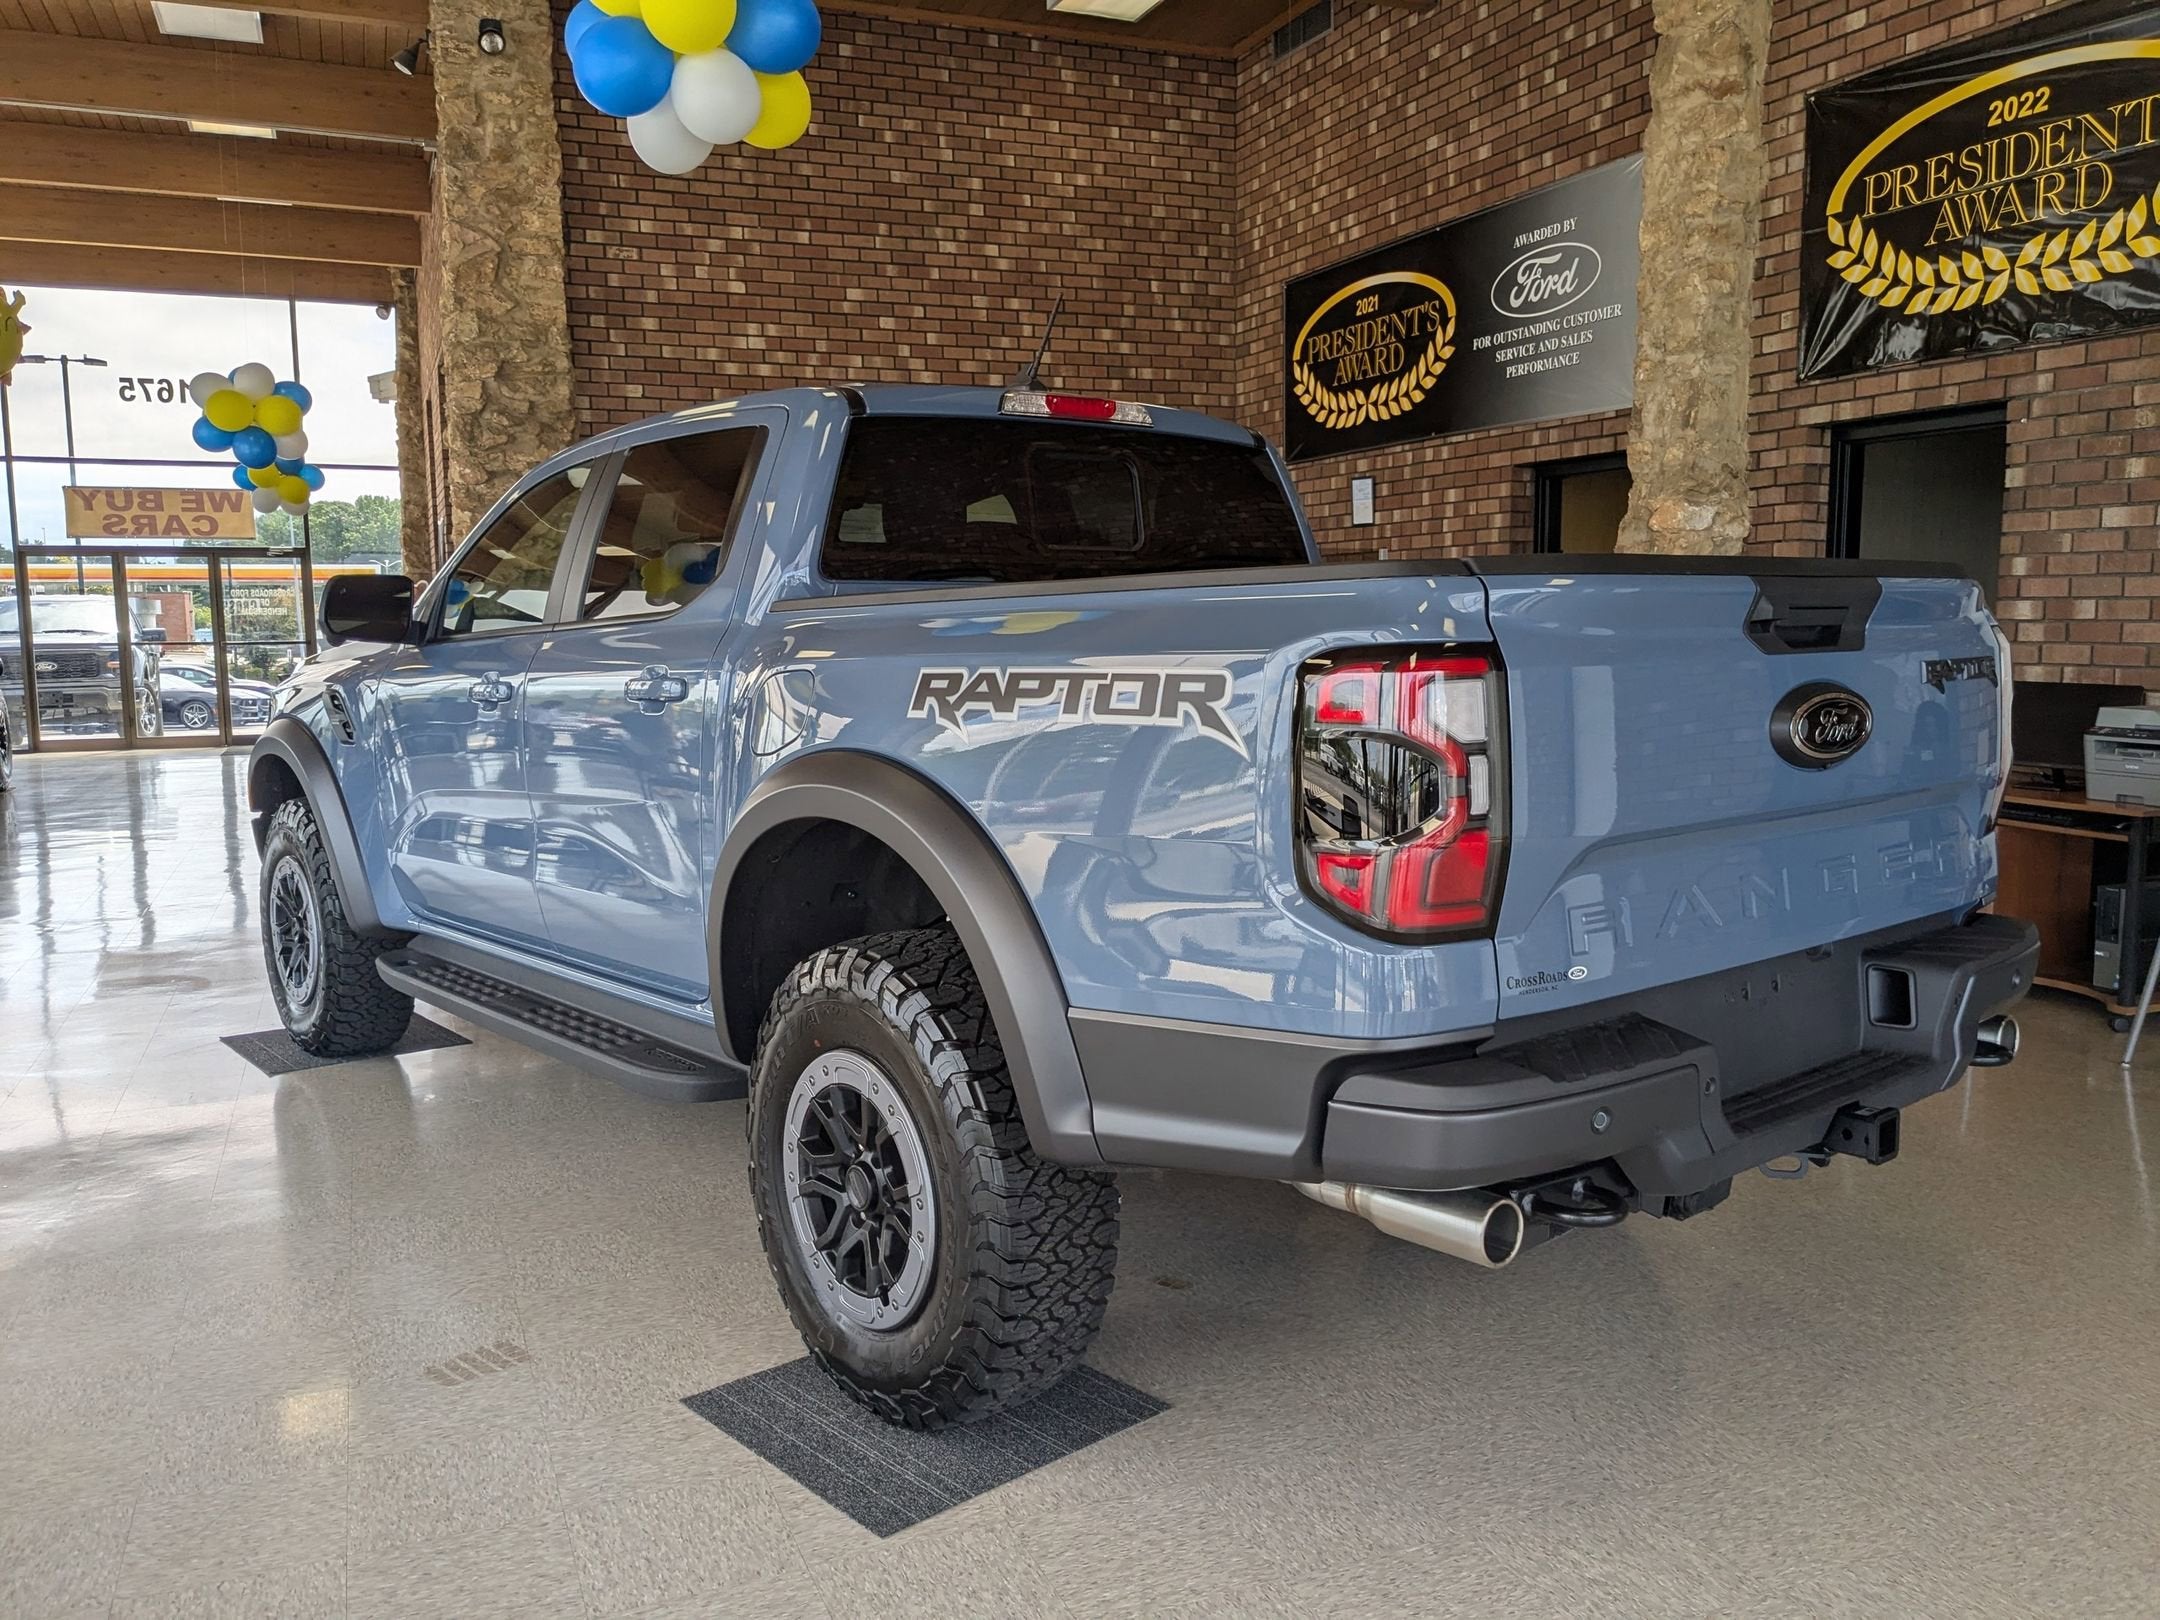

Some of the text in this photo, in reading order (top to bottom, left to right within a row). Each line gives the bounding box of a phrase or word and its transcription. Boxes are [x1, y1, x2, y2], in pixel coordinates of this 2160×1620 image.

[1987, 86, 2051, 128] 2022
[1924, 161, 2113, 247] AWARD
[1513, 216, 1578, 250] AWARDED BY
[1509, 252, 1580, 308] Ford
[1355, 294, 1379, 316] 2021
[1307, 300, 1440, 365] PRESIDENT'S
[1472, 303, 1622, 351] FOR OUTSTANDING CUSTOMER
[1495, 329, 1593, 363] SERVICE AND SALES
[1332, 342, 1405, 387] AWARD
[1506, 351, 1580, 379] PERFORMANCE
[907, 667, 1251, 762] RAPTOR
[1814, 702, 1859, 744] Ford
